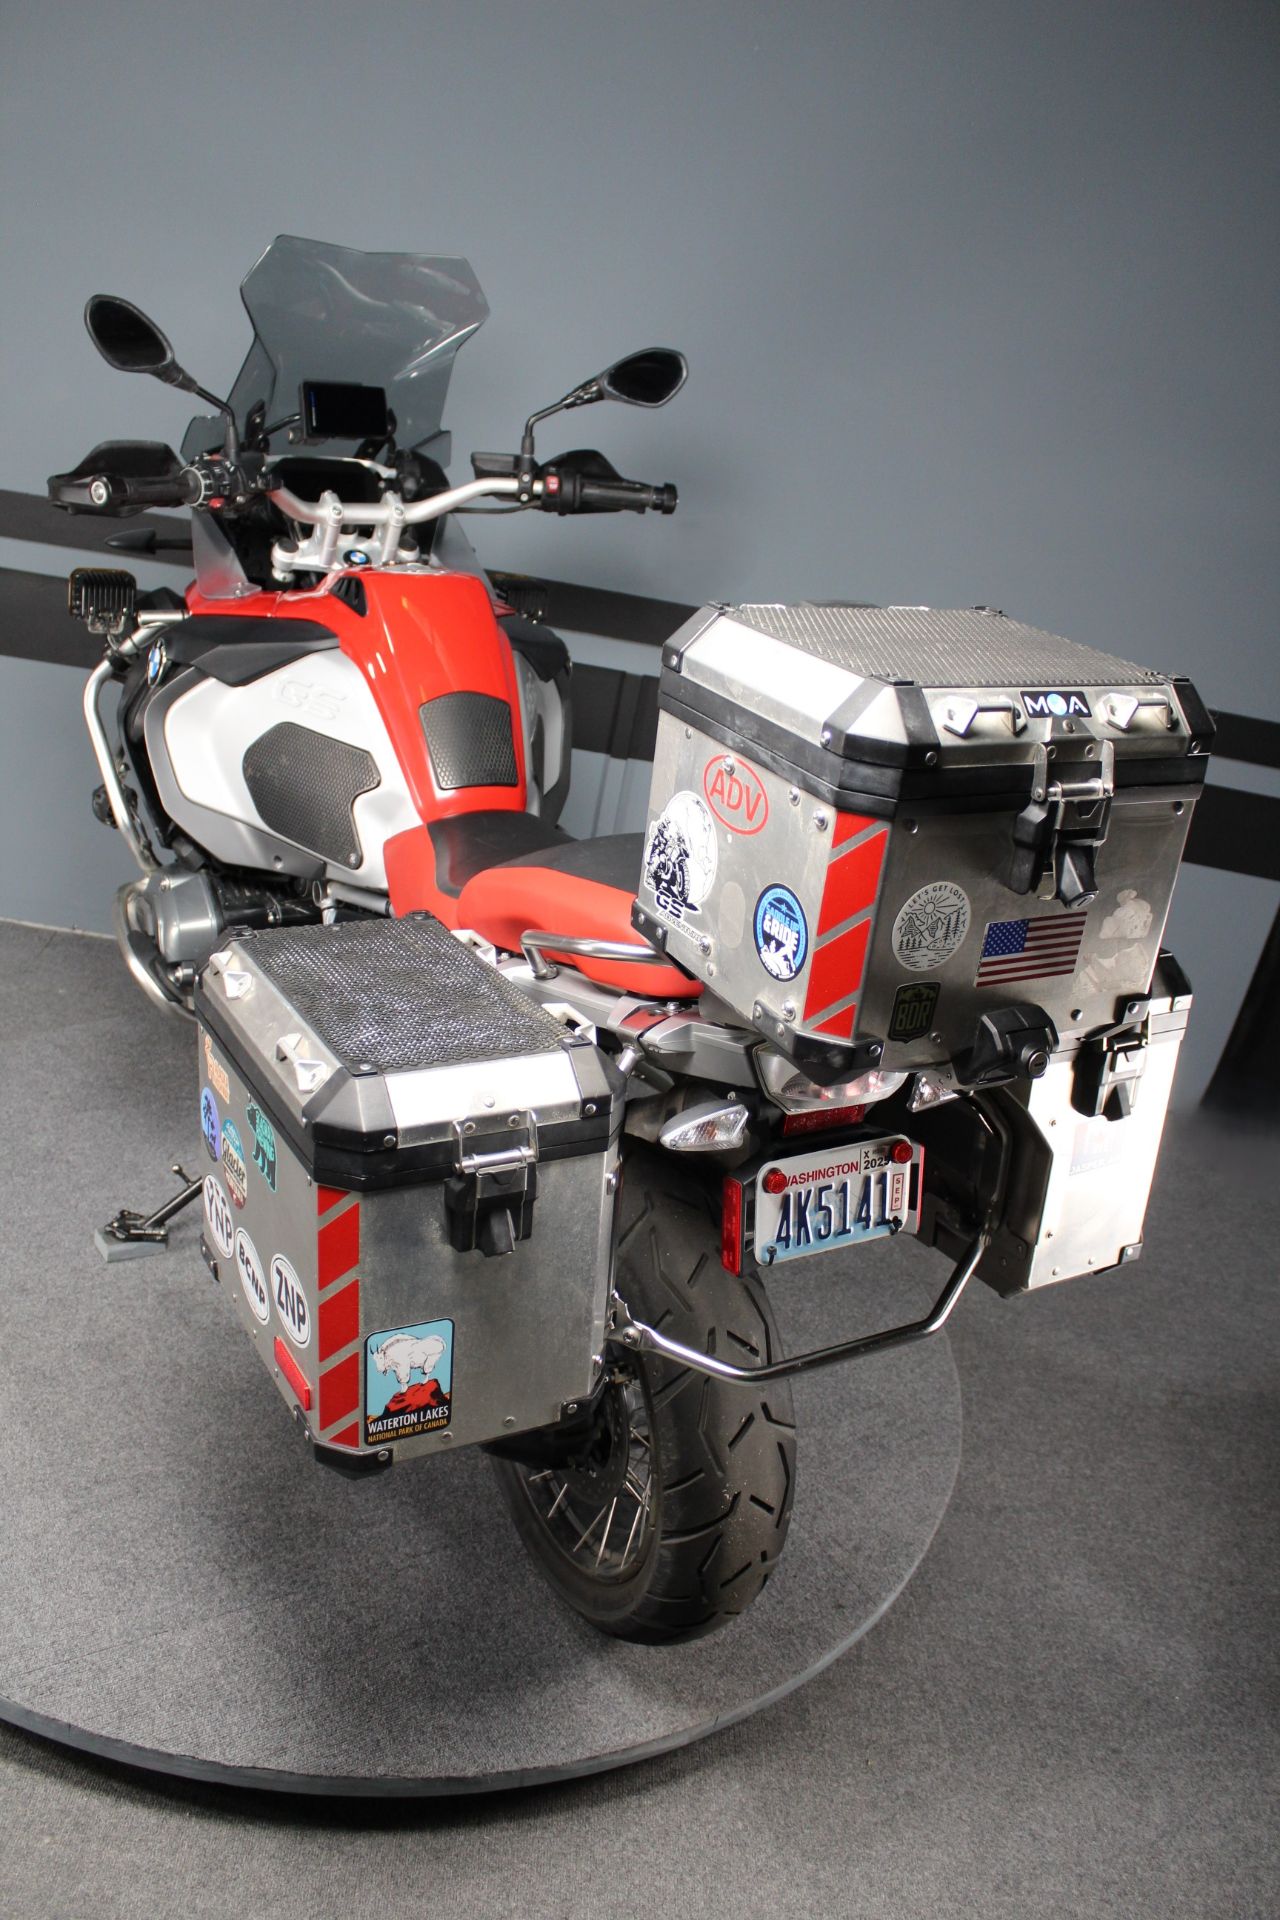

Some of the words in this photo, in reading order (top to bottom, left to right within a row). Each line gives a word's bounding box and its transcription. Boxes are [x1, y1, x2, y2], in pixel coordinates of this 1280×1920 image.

[709, 768, 762, 822] ADV
[656, 890, 685, 919] GS
[908, 890, 929, 909] LET'S
[949, 887, 966, 903] LOST
[896, 1001, 930, 1030] BDR
[863, 1150, 870, 1159] X
[863, 1156, 890, 1170] 2025
[775, 1171, 890, 1249] 4K5141
[239, 1240, 266, 1305] BCNP
[275, 1265, 306, 1334] ZNP
[367, 1412, 418, 1434] WATERTON
[420, 1405, 449, 1422] LAKES
[367, 1431, 397, 1443] NATIONAL
[398, 1426, 414, 1436] PARK
[414, 1423, 423, 1431] OF
[423, 1418, 448, 1430] CANADA
